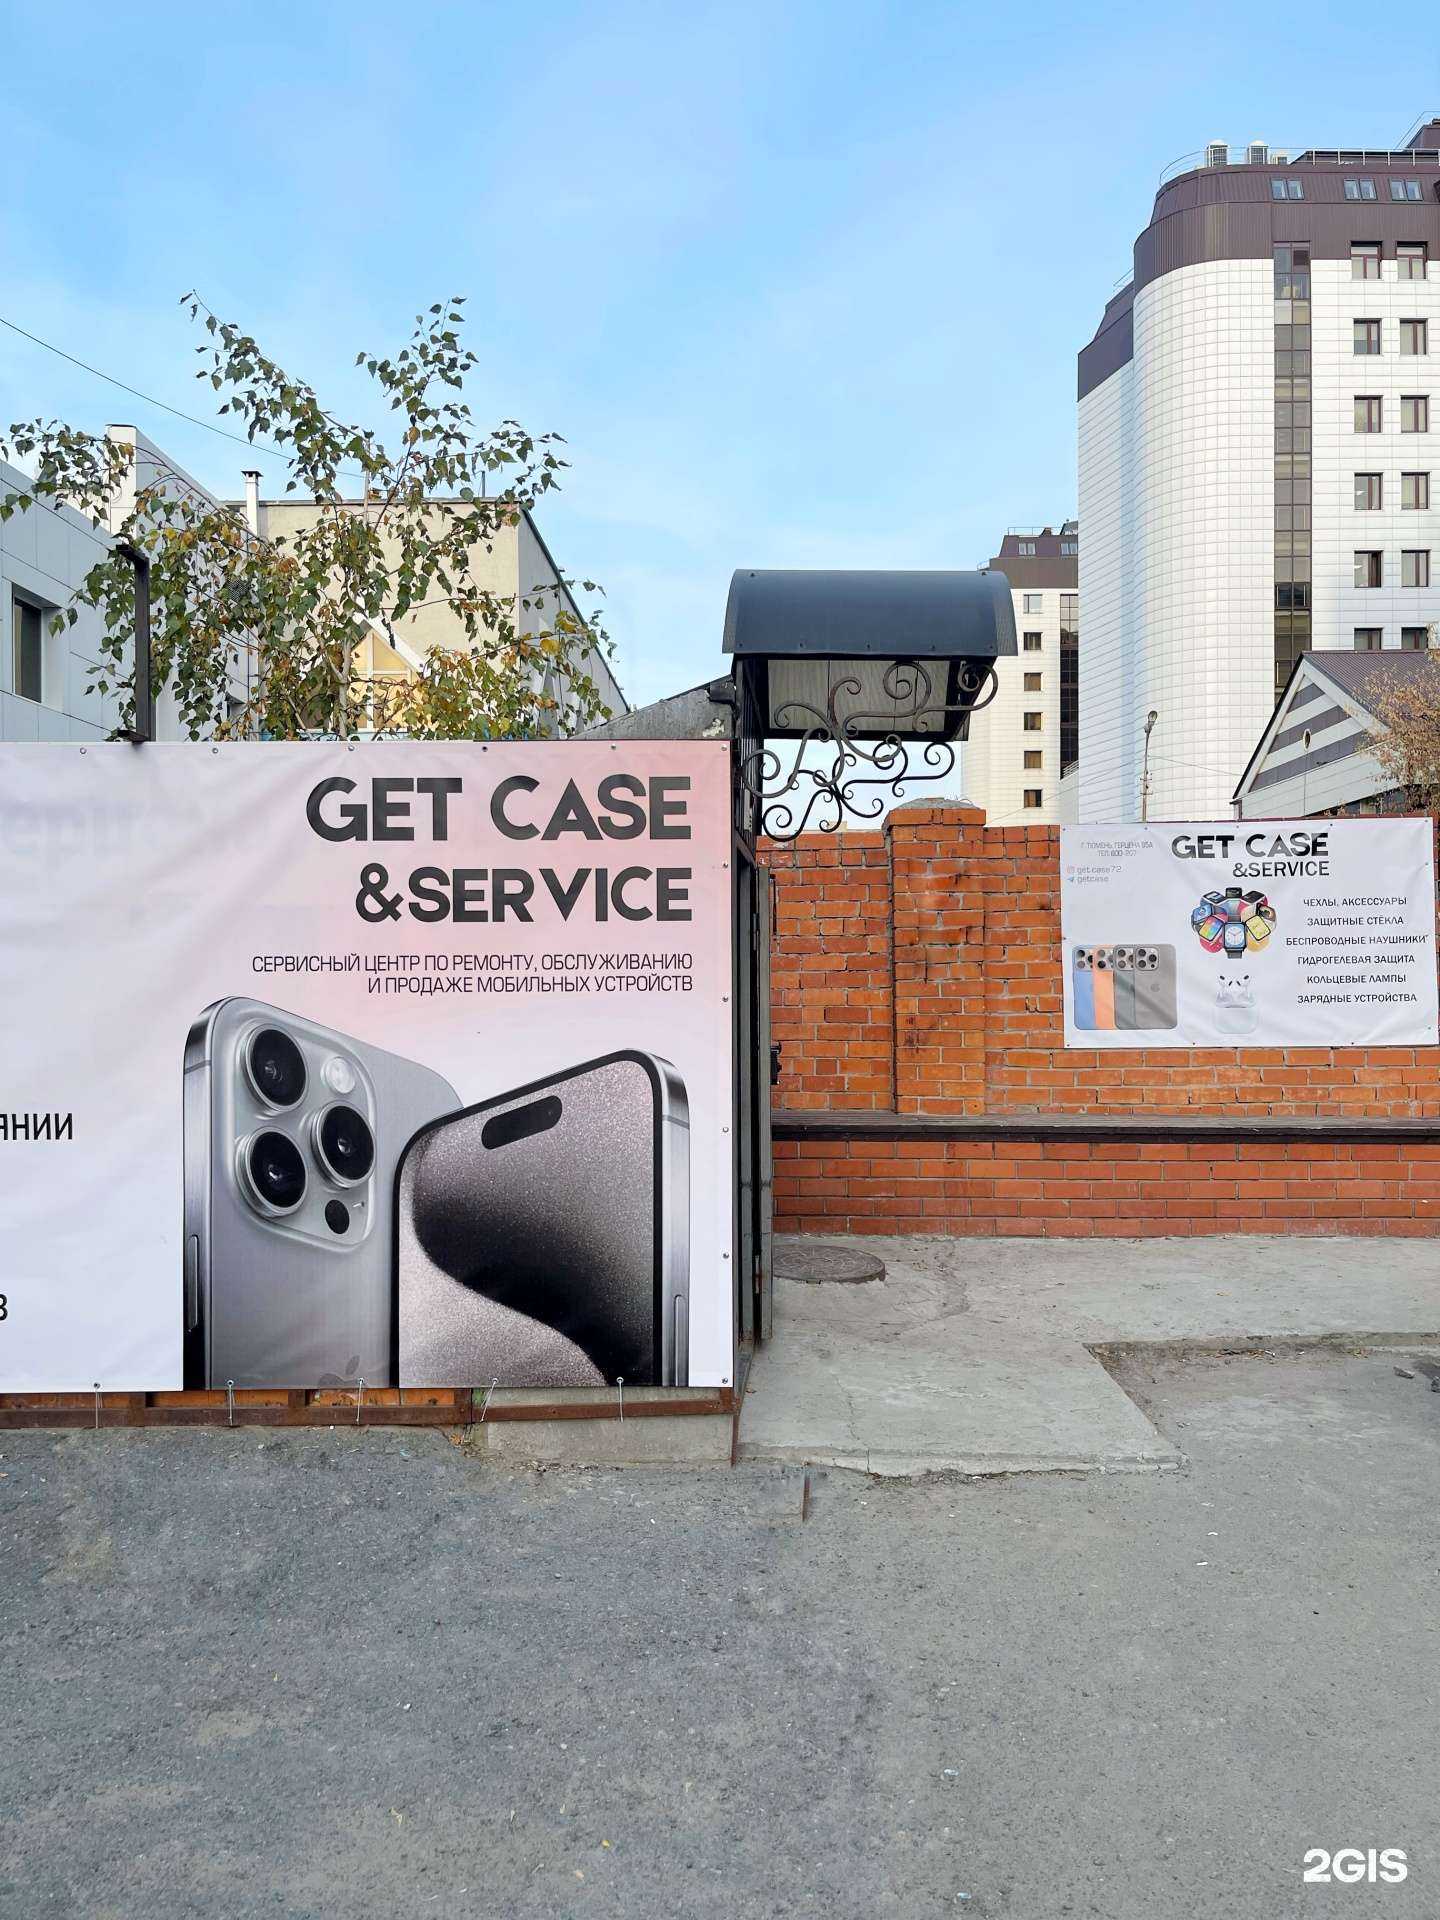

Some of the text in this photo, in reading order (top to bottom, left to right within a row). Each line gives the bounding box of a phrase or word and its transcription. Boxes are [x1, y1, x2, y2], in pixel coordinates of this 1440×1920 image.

[306, 774, 691, 842] GET CASE
[1172, 832, 1328, 859] GET CASE
[1232, 860, 1329, 877] &SERVICE
[355, 862, 692, 923] &SERVICE
[1342, 897, 1407, 906] АКСЕССУАРЫ
[1307, 917, 1364, 927] ЗАЩИТНЫЕ
[1286, 935, 1426, 946] БЕСПРОВОДНЫЕ НАУШНИКИ
[252, 953, 693, 974] СЕРВИСНЫЙ ЦЕНТР ПО РЕМОНТУ, ОБСЛУЖИВАНИЮ
[1297, 954, 1415, 965] ГИДРОГЕЛЕВАЯ ЗАЩИТА
[368, 973, 693, 996] И ПРОДАЖЕ МОБИЛЬНЫХ УСТРОЙСТВ
[1307, 974, 1406, 984] КОЛЬЦЕВЫЕ ЛАМПЫ
[1297, 992, 1417, 1004] ЗАРЯДНЫЕ УСТРОЙСТВА
